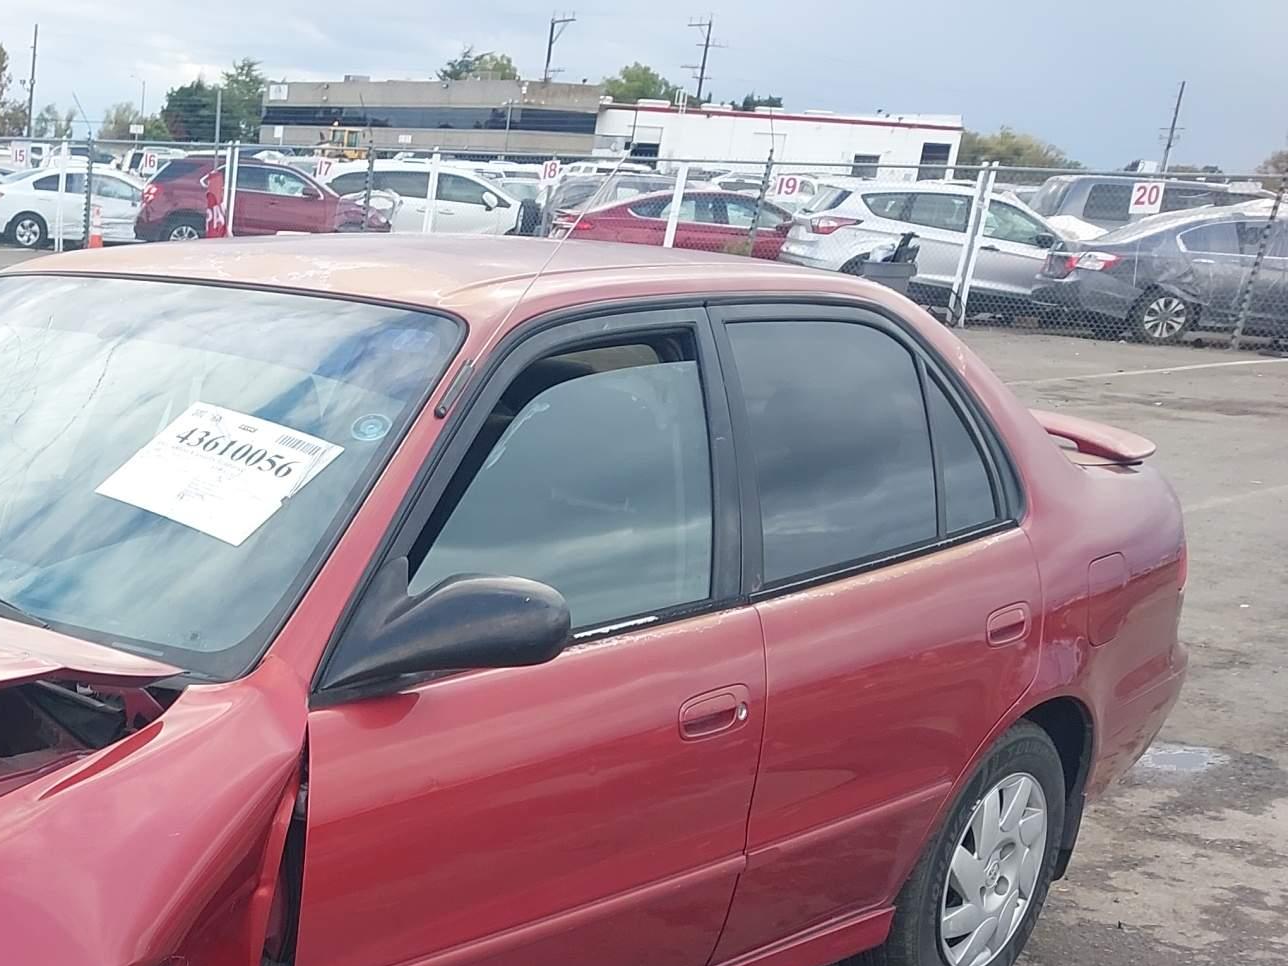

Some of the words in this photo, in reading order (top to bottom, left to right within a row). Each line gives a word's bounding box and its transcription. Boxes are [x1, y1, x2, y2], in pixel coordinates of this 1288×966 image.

[15, 149, 25, 162] 15
[144, 153, 156, 168] 16
[318, 160, 332, 176] 17
[543, 162, 558, 179] 18
[777, 177, 797, 195] 19
[1134, 185, 1160, 205] 20
[175, 427, 302, 478] 43610056
